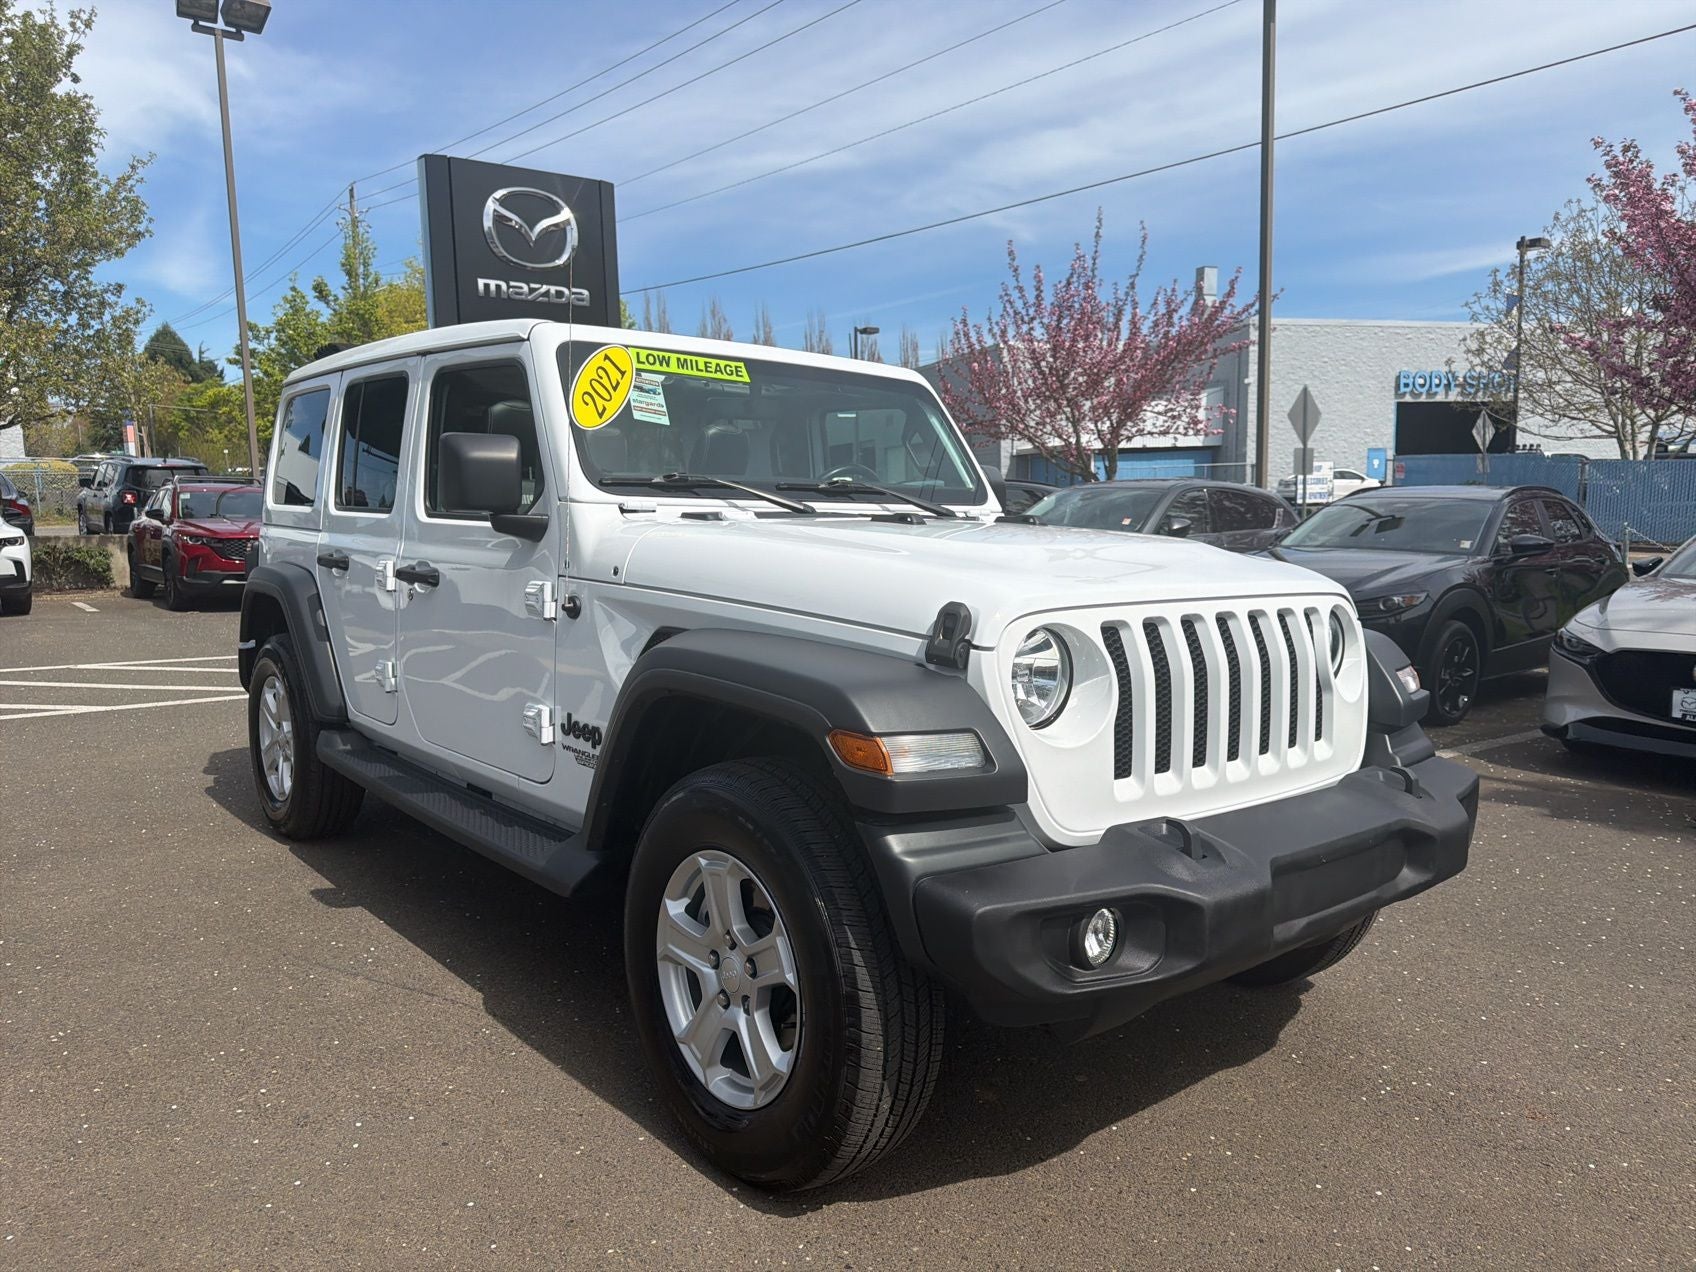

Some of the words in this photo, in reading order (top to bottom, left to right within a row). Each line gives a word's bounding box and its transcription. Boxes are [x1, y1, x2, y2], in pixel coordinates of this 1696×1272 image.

[477, 278, 590, 306] mazda
[636, 352, 671, 368] LOW
[676, 357, 744, 378] MILEAGE
[581, 353, 627, 419] 2021
[1399, 370, 1457, 393] BODY
[561, 712, 602, 749] Jeep
